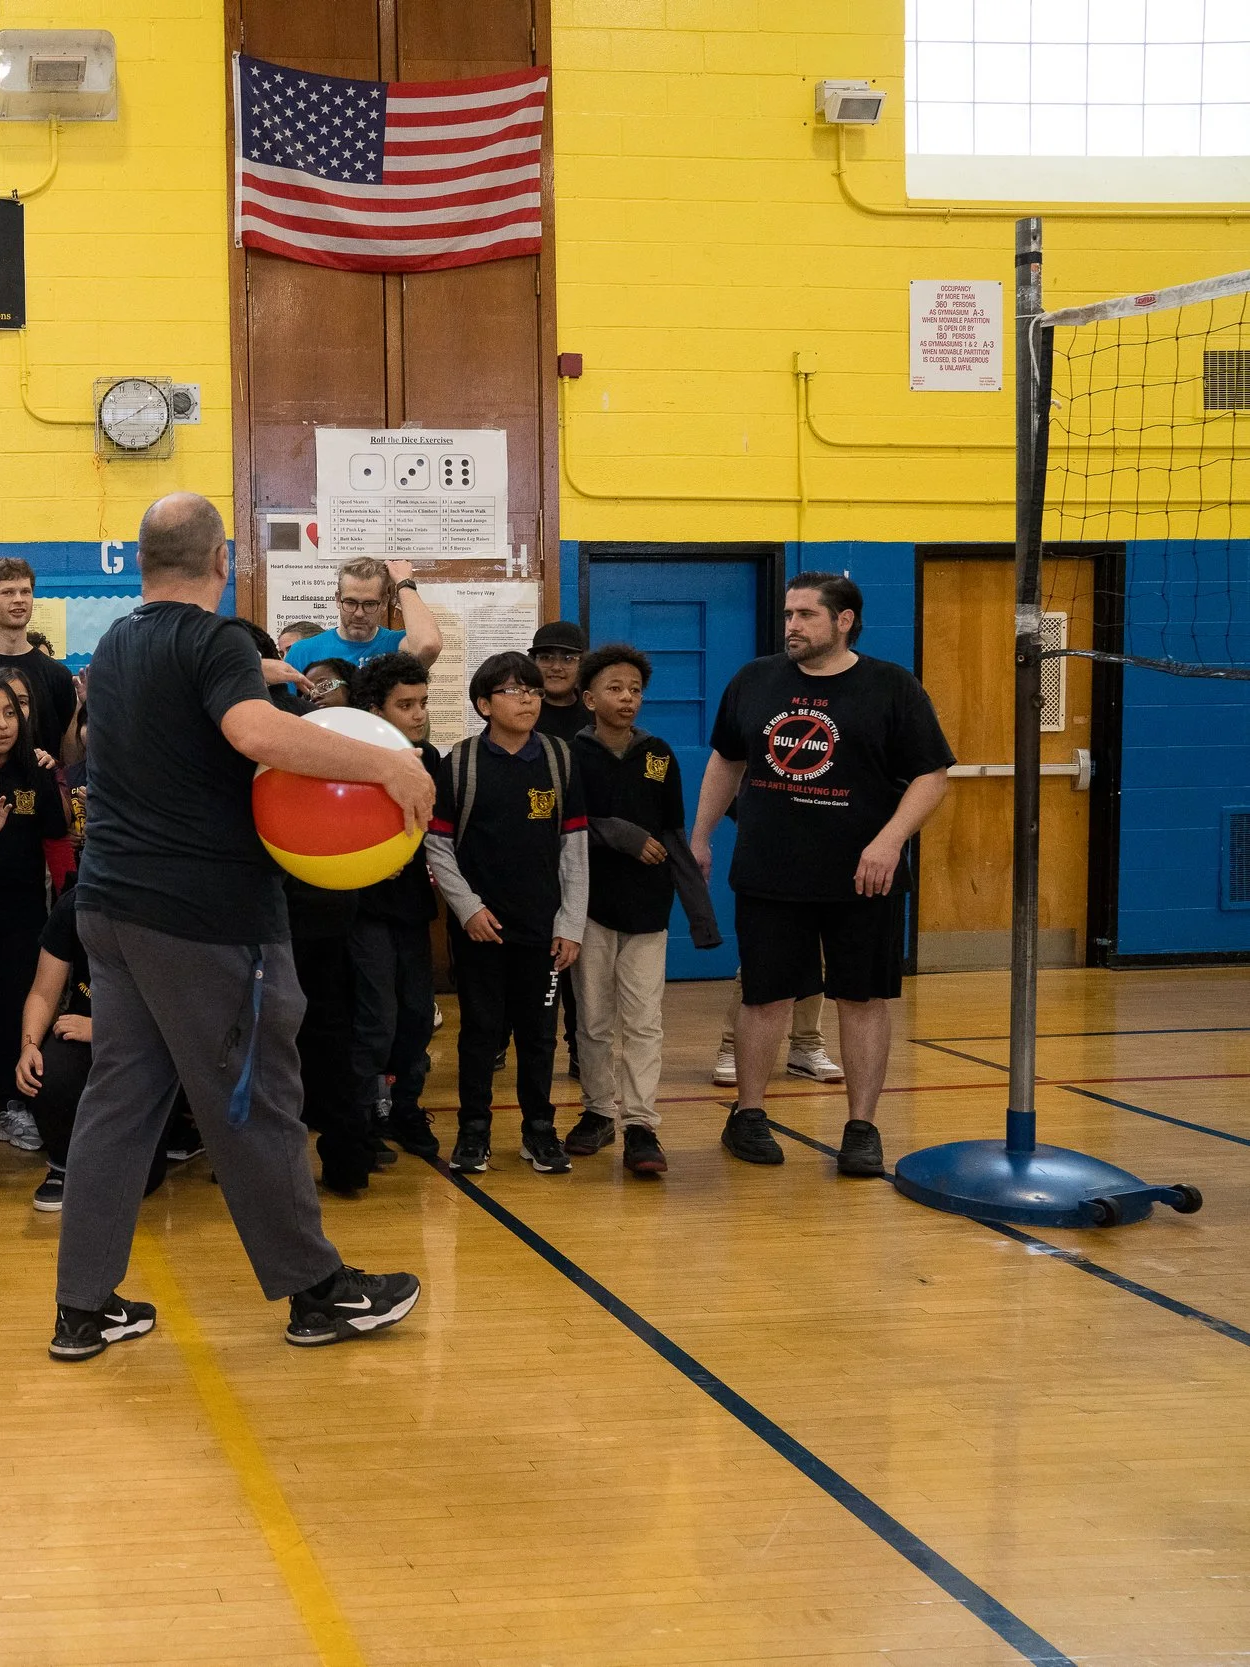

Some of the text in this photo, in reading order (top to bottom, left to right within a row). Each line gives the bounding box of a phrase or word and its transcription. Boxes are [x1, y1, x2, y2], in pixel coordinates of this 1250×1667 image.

[370, 436, 453, 444] Roll the Dice Exercises
[101, 541, 124, 574] G
[506, 544, 527, 577] H
[792, 697, 809, 706] M.S.
[763, 725, 772, 735] BE
[770, 712, 788, 724] KIND
[810, 710, 840, 743] RESPECTFUL
[774, 736, 828, 751] BULLYING
[765, 754, 773, 763] BE
[771, 763, 785, 776] FAIR
[804, 760, 834, 780] FRIENDS
[768, 782, 785, 790] ANTI
[788, 784, 829, 795] BULLYING
[832, 789, 849, 797] DAY
[544, 971, 559, 1006] Hurl
